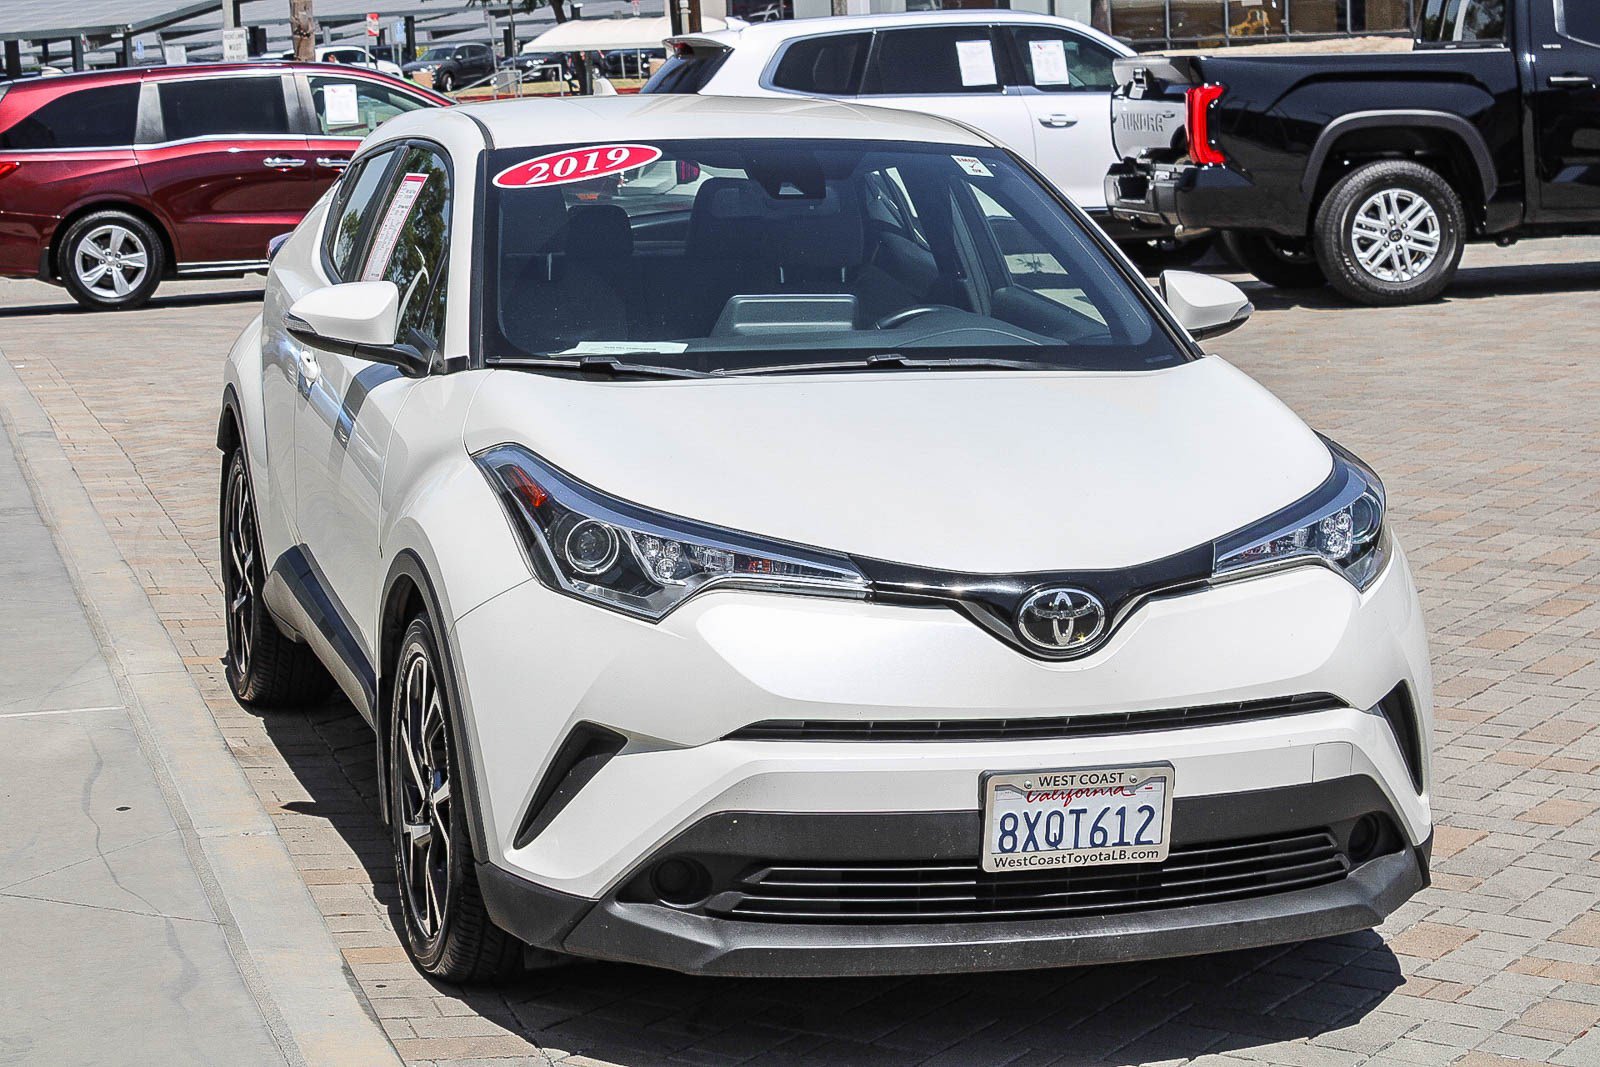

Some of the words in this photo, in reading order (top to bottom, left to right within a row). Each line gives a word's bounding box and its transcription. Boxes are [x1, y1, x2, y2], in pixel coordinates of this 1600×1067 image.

[1120, 112, 1164, 132] TUNDRA
[525, 147, 631, 184] 2019
[1038, 775, 1076, 787] WEST
[1079, 772, 1124, 785] COAST
[1026, 785, 1136, 807] California
[998, 804, 1155, 853] 8XQT612
[994, 850, 1159, 868] WestCoastToyotaLB.com
